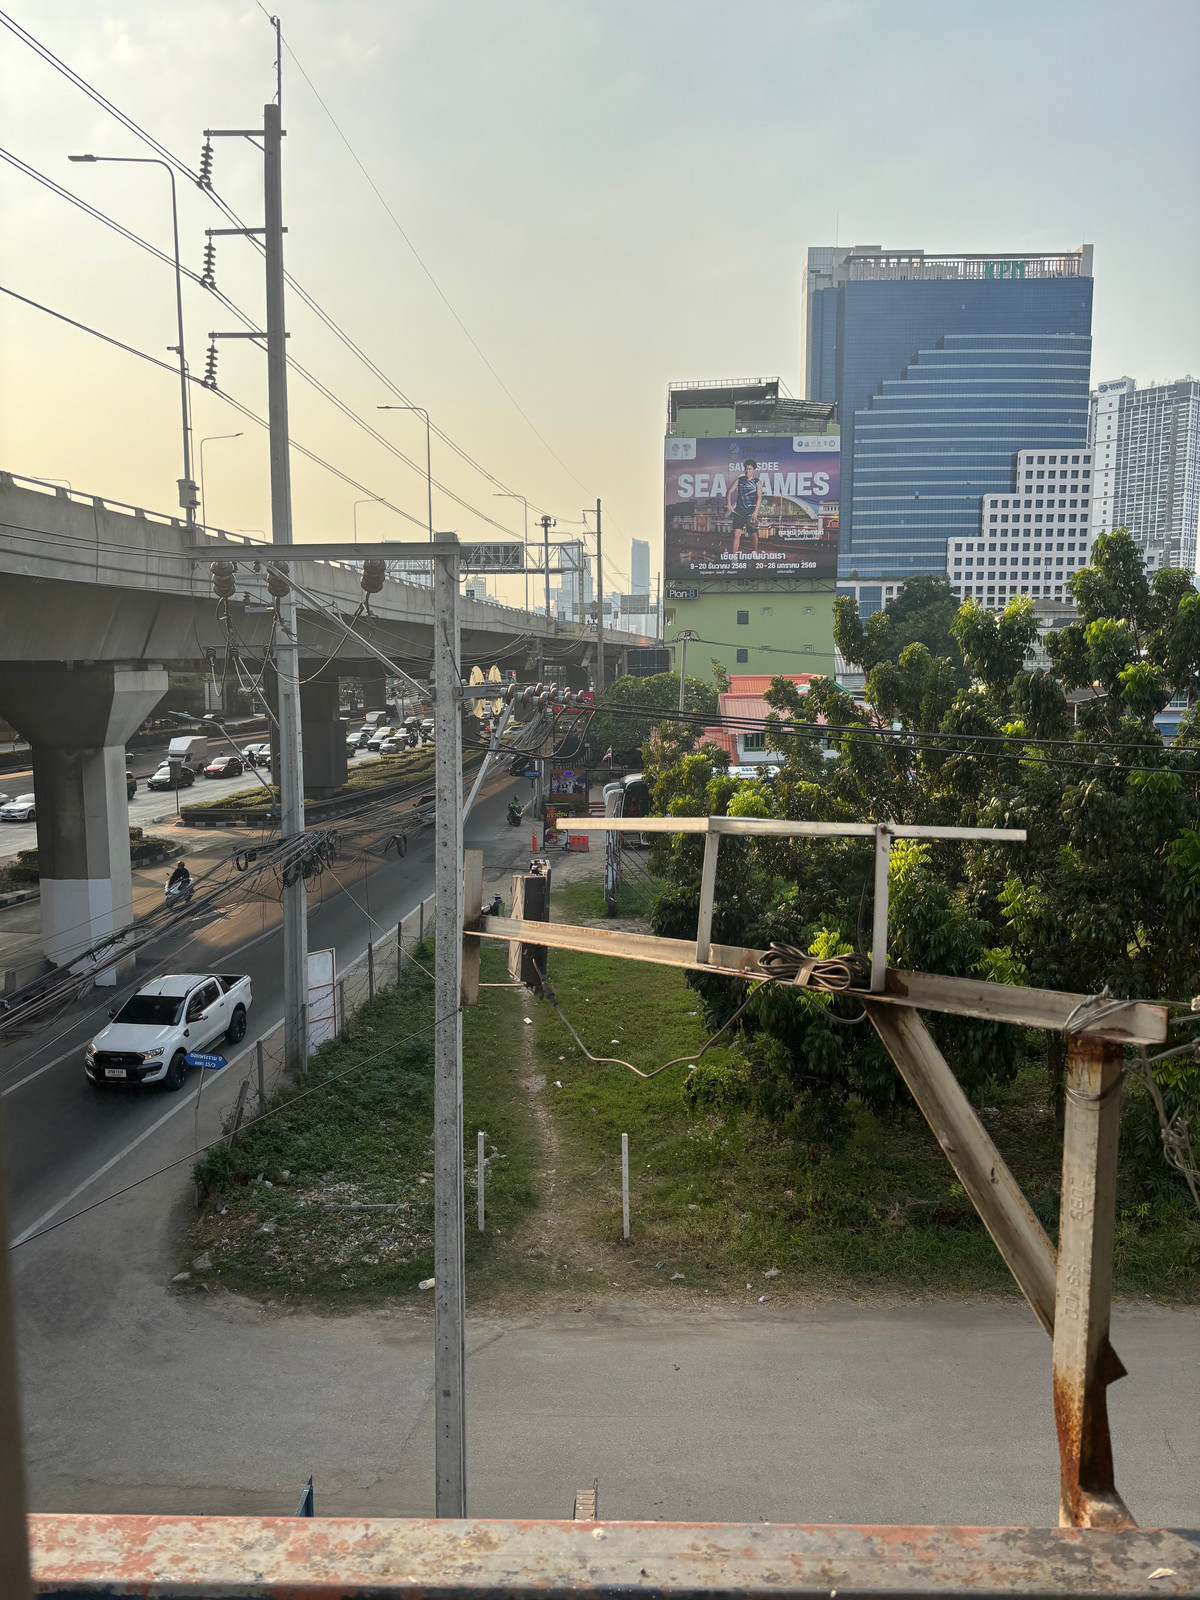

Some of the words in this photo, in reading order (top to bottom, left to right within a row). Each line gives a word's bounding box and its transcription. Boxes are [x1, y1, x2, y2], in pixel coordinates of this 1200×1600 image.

[985, 261, 1025, 280] KPN
[677, 473, 727, 498] SEA
[742, 471, 830, 497] AMES
